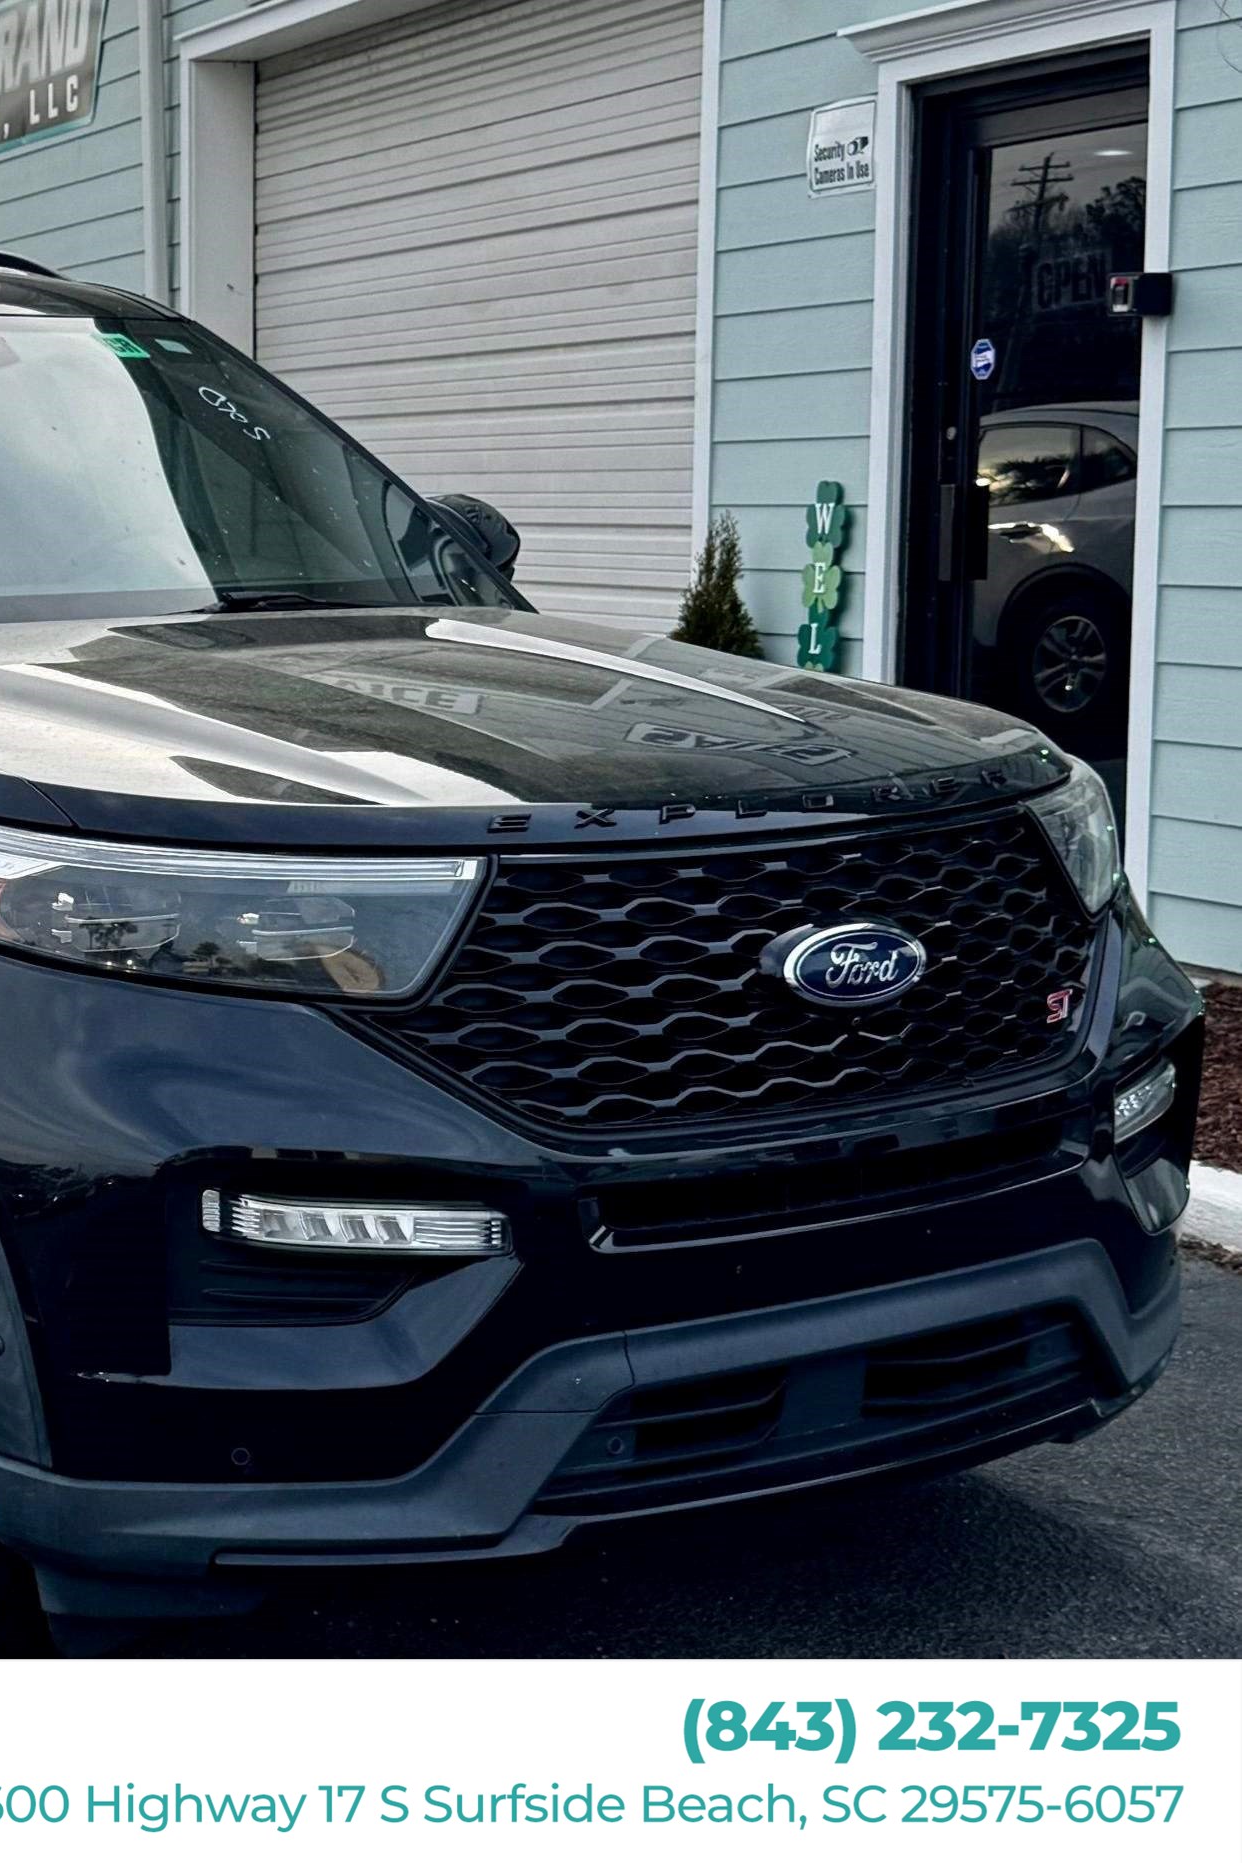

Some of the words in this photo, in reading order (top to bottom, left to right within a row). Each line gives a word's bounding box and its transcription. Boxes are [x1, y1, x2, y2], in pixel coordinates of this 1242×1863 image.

[29, 75, 79, 125] LLC
[814, 141, 845, 162] Security
[814, 167, 845, 185] Cameras
[825, 941, 901, 988] Ford
